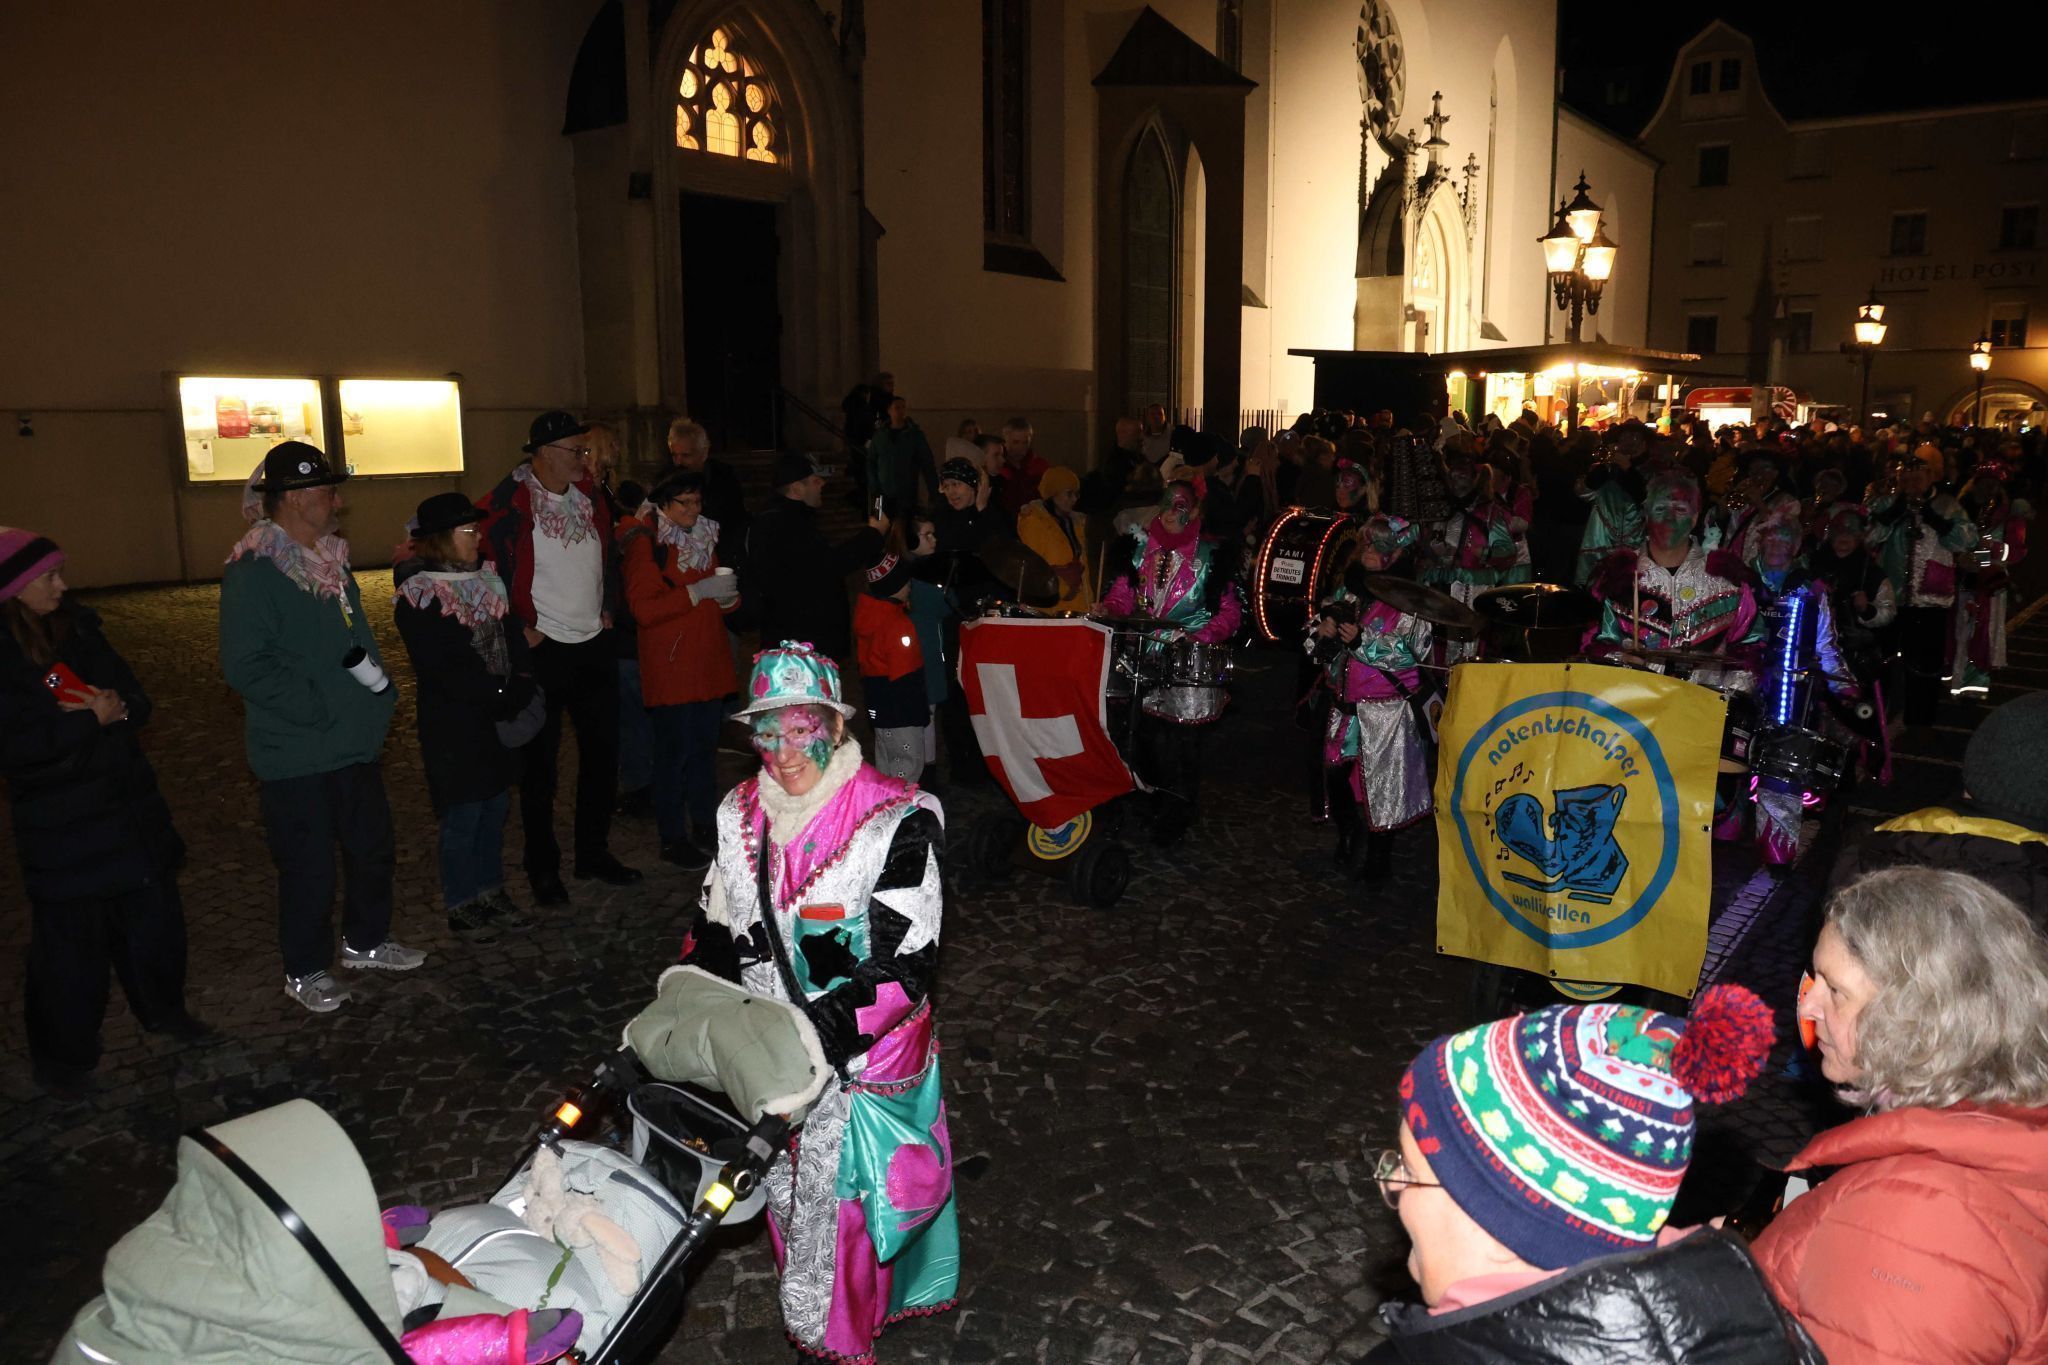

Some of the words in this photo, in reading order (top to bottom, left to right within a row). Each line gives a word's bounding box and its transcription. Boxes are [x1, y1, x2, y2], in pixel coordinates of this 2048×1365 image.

[1880, 265, 1963, 283] HOTEL
[1972, 261, 2037, 280] POST
[1487, 713, 1640, 778] notentschalper
